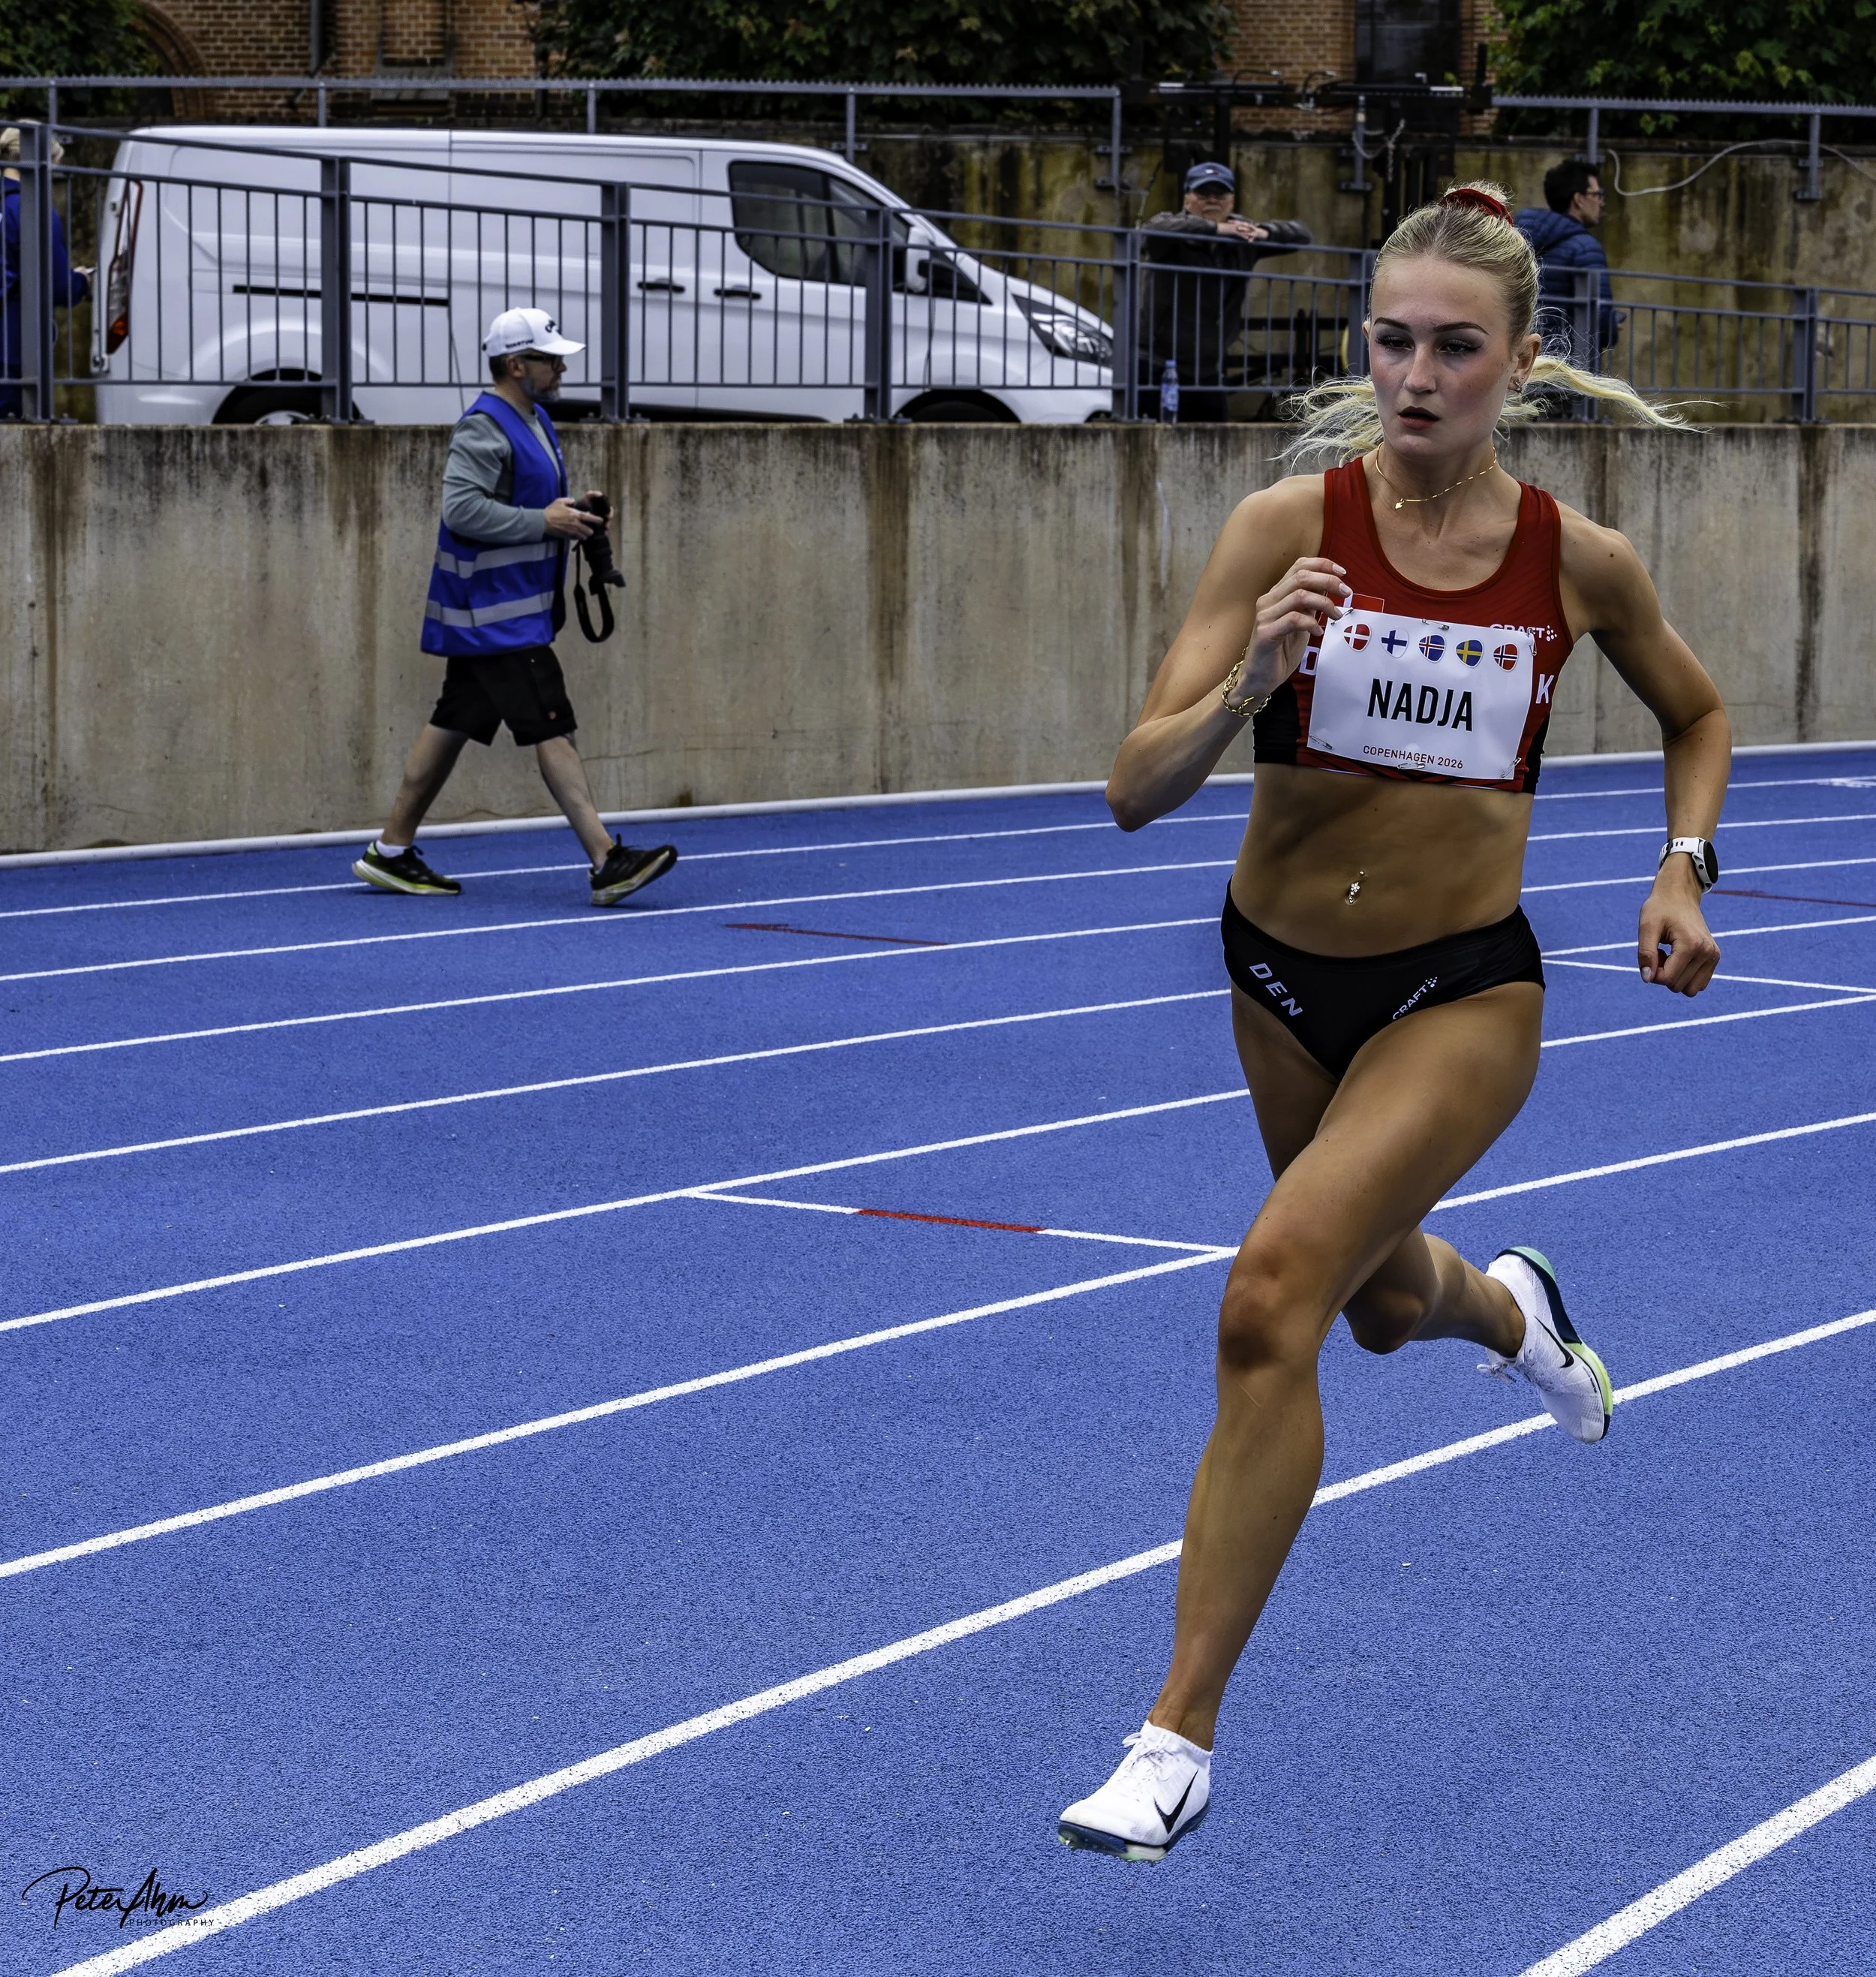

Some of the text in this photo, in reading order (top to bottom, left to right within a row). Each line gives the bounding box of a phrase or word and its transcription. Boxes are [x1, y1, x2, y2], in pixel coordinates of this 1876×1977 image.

[1366, 678, 1473, 732] NADJA
[1363, 745, 1463, 769] COPENHAGEN 2026
[1249, 962, 1303, 1016] DEN
[1392, 984, 1427, 1020] CRAFT
